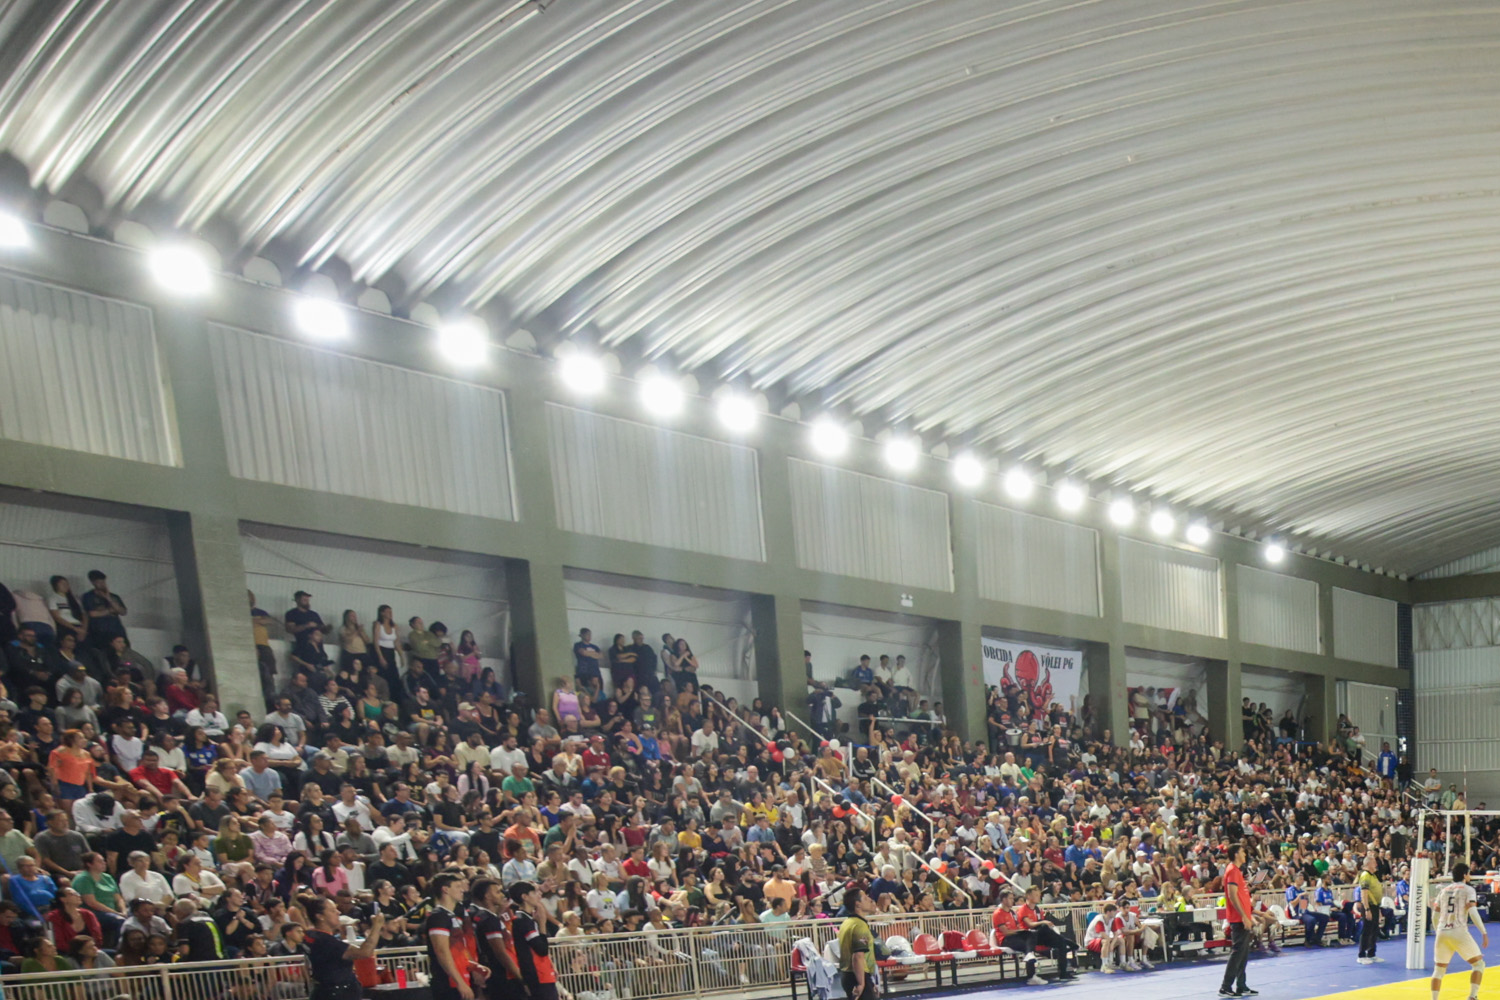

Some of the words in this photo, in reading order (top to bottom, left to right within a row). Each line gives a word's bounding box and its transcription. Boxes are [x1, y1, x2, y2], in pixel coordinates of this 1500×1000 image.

[983, 645, 1013, 663] ORCIDA
[1063, 658, 1074, 669] PG
[1447, 896, 1455, 913] 5
